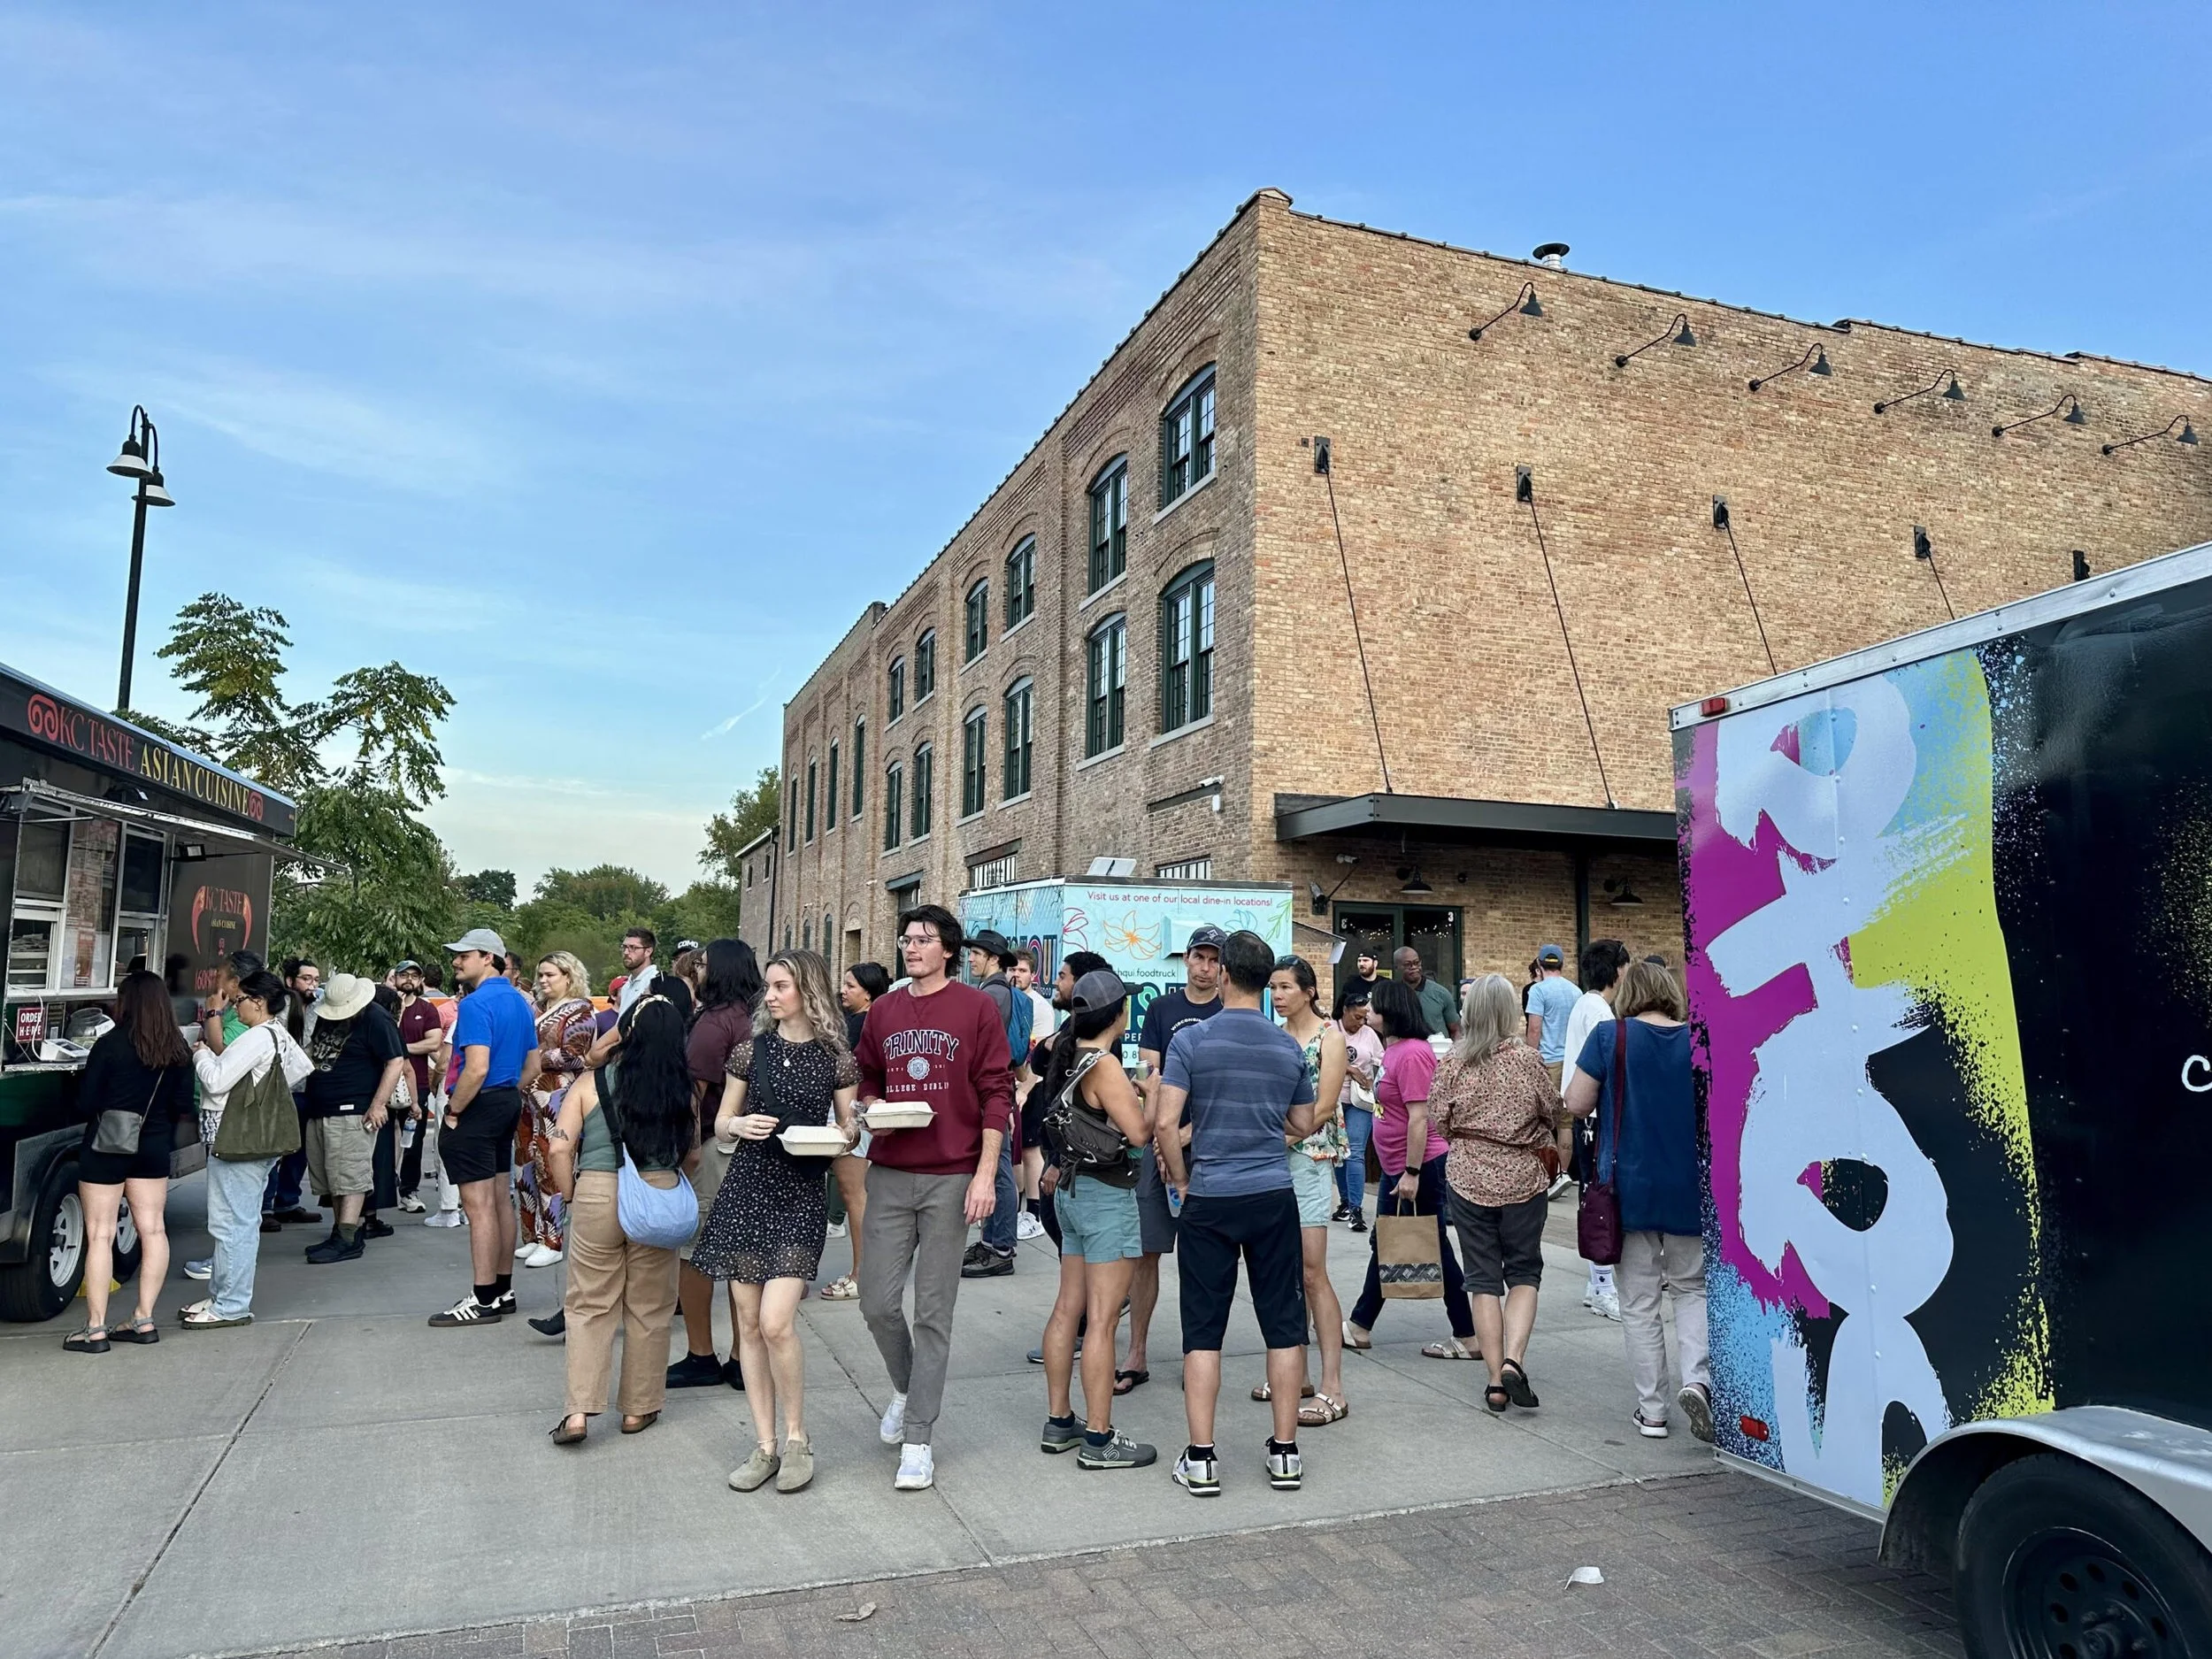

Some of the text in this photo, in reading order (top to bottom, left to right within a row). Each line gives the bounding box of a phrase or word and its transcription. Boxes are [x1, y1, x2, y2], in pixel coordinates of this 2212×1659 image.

[59, 705, 250, 816] KC TASTE ASIAN CUISINE
[204, 884, 242, 916] KC TASTE
[1087, 891, 1106, 901] Visit
[1152, 894, 1162, 902] of
[1180, 895, 1200, 904] local
[1202, 895, 1231, 905] dine-in
[1233, 896, 1272, 906] locations!
[1448, 911, 1454, 922] 3
[678, 940, 698, 949] COMO
[20, 1012, 42, 1024] ORDER
[883, 1030, 959, 1061] TRINITY
